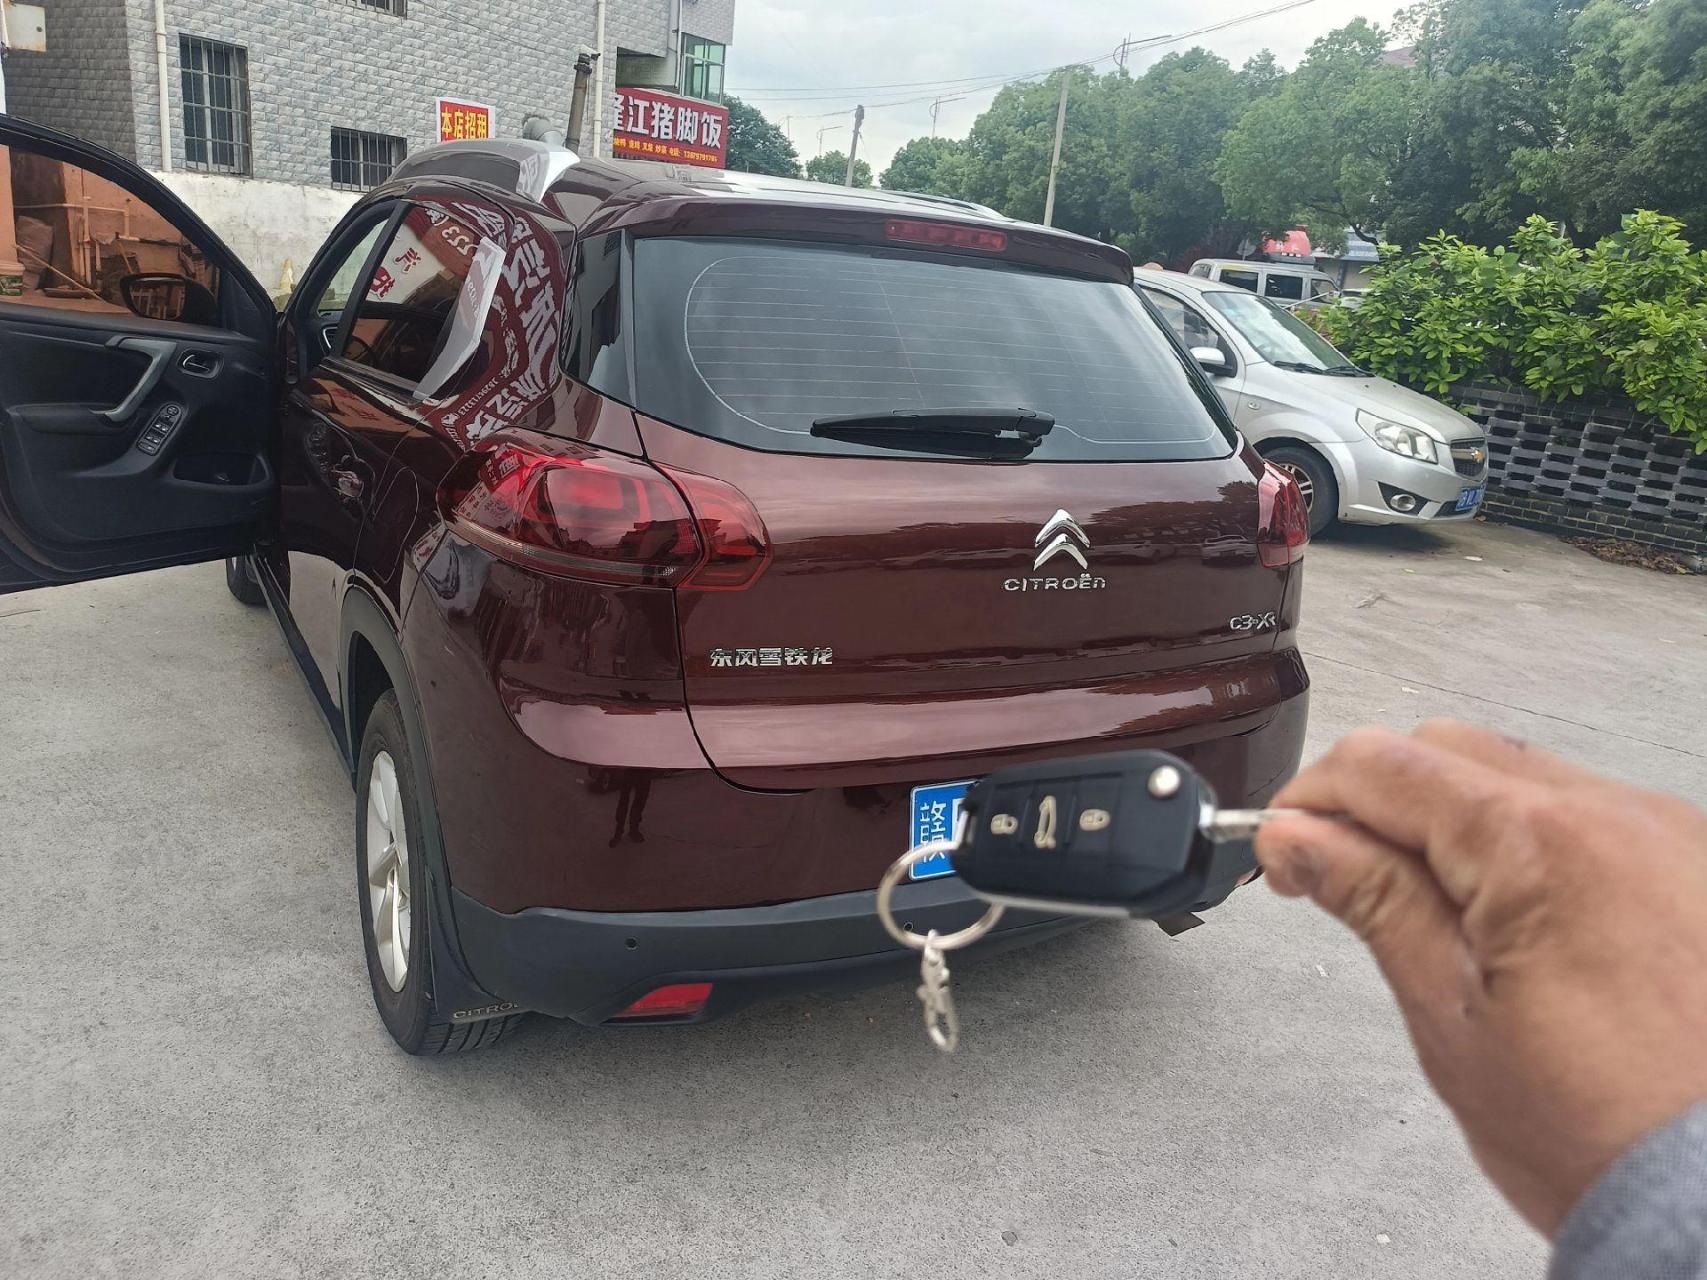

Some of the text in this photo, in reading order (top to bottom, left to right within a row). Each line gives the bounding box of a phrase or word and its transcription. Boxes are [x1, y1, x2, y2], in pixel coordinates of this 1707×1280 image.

[441, 106, 487, 140] 本店招租
[709, 647, 833, 667] 东风雪铁龙
